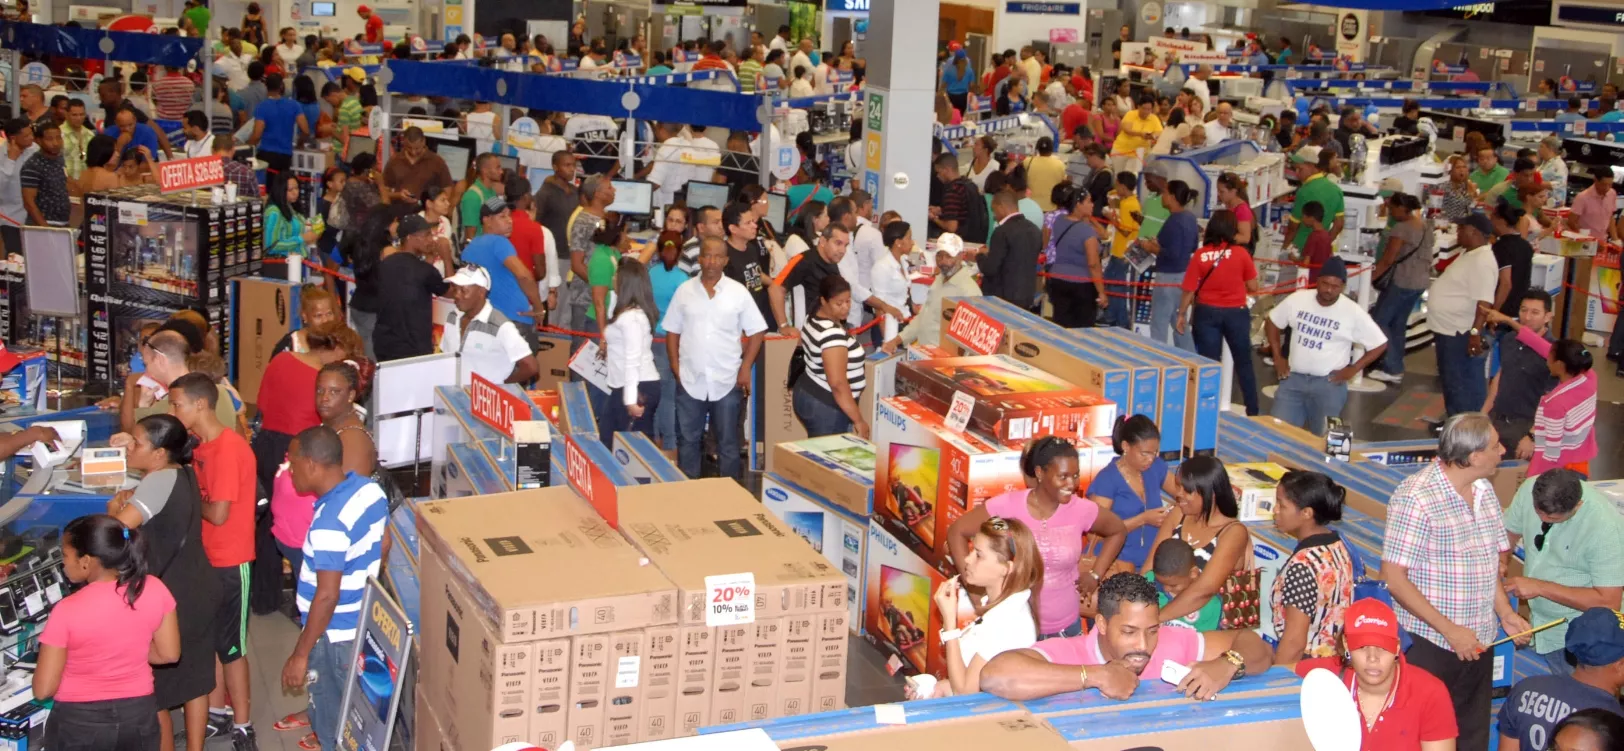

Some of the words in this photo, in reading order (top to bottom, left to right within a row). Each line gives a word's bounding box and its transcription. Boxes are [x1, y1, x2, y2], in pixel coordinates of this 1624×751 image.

[1021, 4, 1064, 12] FRIGIDAIRE
[1156, 40, 1194, 51] KitchenAid
[869, 101, 881, 120] 24
[584, 131, 605, 143] USA
[161, 162, 195, 189] OFERTA
[1200, 249, 1233, 263] STAFF
[90, 294, 123, 305] Quasar
[1296, 310, 1341, 331] HEIGHTS
[1586, 299, 1596, 329] PHILIPS
[950, 305, 980, 343] OFERTA
[1296, 322, 1333, 340] TENNIS
[1298, 335, 1324, 350] 1994
[473, 379, 502, 425] OFERTA
[880, 404, 907, 433] PHILIPS
[784, 422, 793, 433] TV
[566, 440, 593, 502] OFERTA
[753, 513, 785, 537] Panasonic
[870, 525, 898, 556] PHILIPS
[461, 537, 489, 563] Panasonic
[713, 586, 750, 603] 20%
[755, 596, 765, 608] 40
[597, 609, 606, 621] 40
[713, 604, 733, 614] 10%
[372, 601, 400, 651] OFERTA
[787, 700, 798, 709] 40
[823, 697, 834, 707] 40
[722, 711, 734, 720] 40
[754, 705, 765, 715] 40
[651, 717, 662, 727] 40
[687, 713, 698, 723] 40
[542, 733, 554, 743] 40
[579, 727, 591, 737] 40
